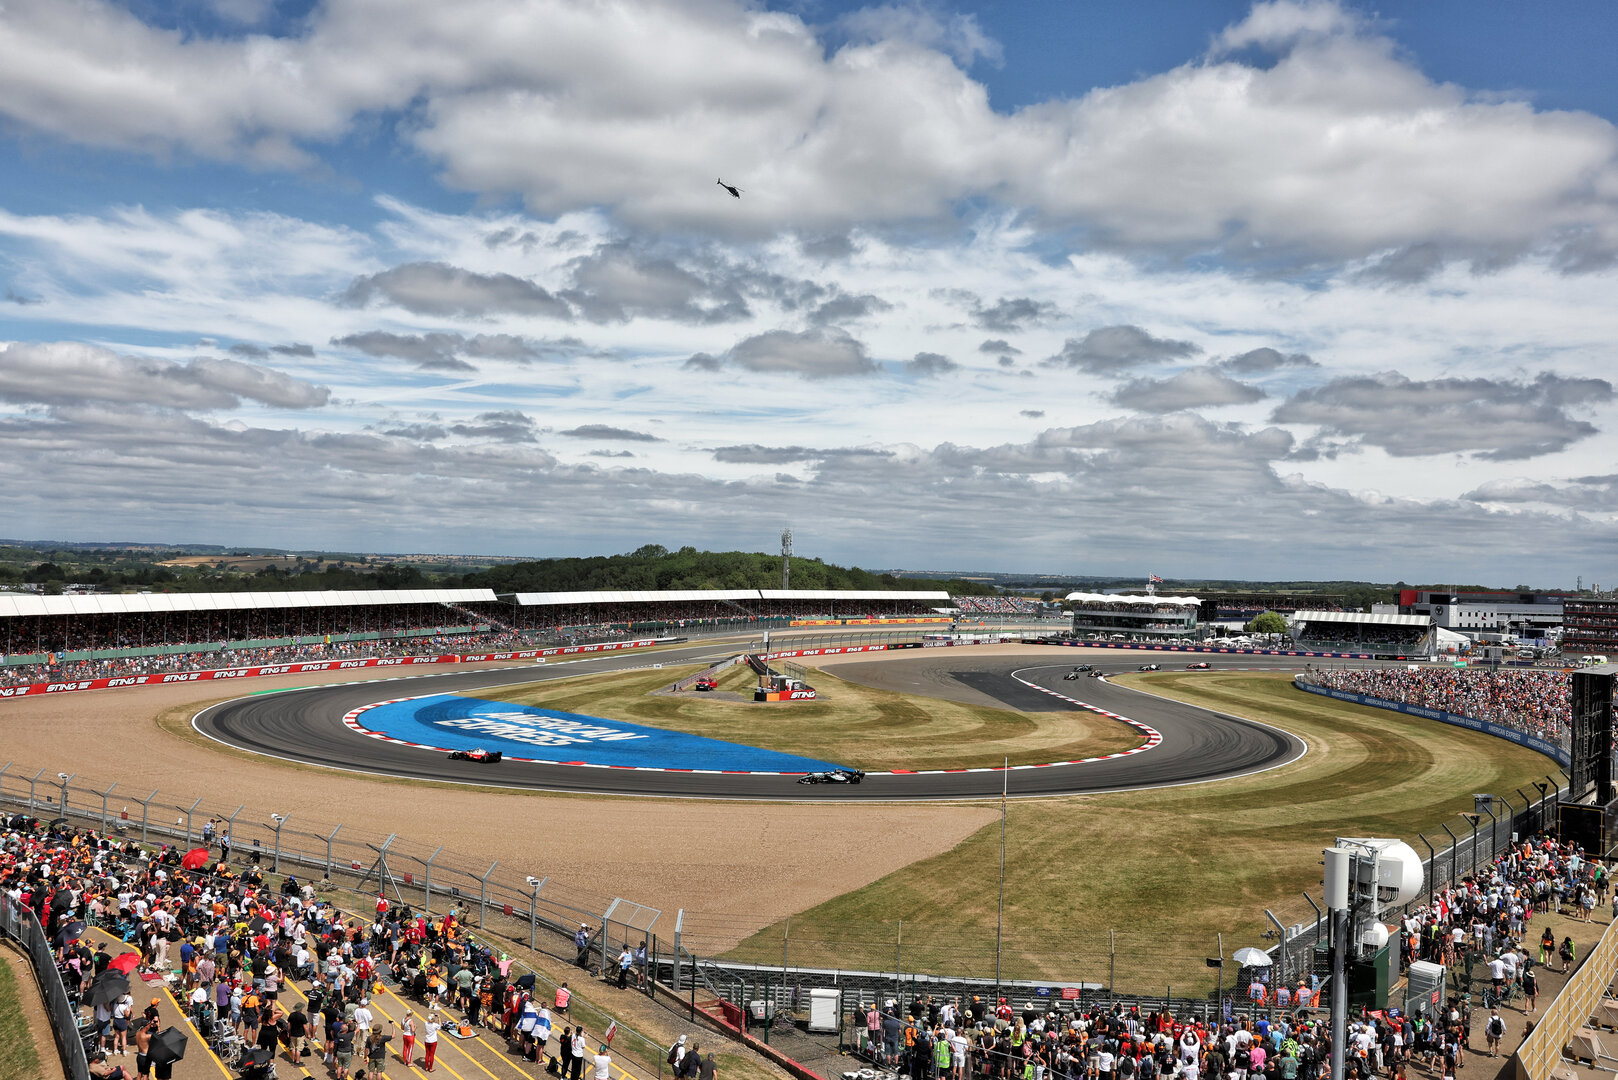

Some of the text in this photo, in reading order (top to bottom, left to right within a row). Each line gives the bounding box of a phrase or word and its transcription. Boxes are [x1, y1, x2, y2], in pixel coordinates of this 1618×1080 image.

[163, 673, 188, 682] STING
[213, 670, 236, 678] STING
[46, 682, 77, 692] STING
[108, 677, 136, 686] STING
[1365, 698, 1398, 709] AMERICAN EXPRESS
[1406, 706, 1440, 718] AMERICAN EXPRESS
[472, 712, 649, 741] AMERICAN
[1448, 715, 1482, 728] AMERICAN EXPRESS
[433, 718, 593, 746] EXPRESS
[1488, 725, 1520, 740] AMERICAN EXPRESS
